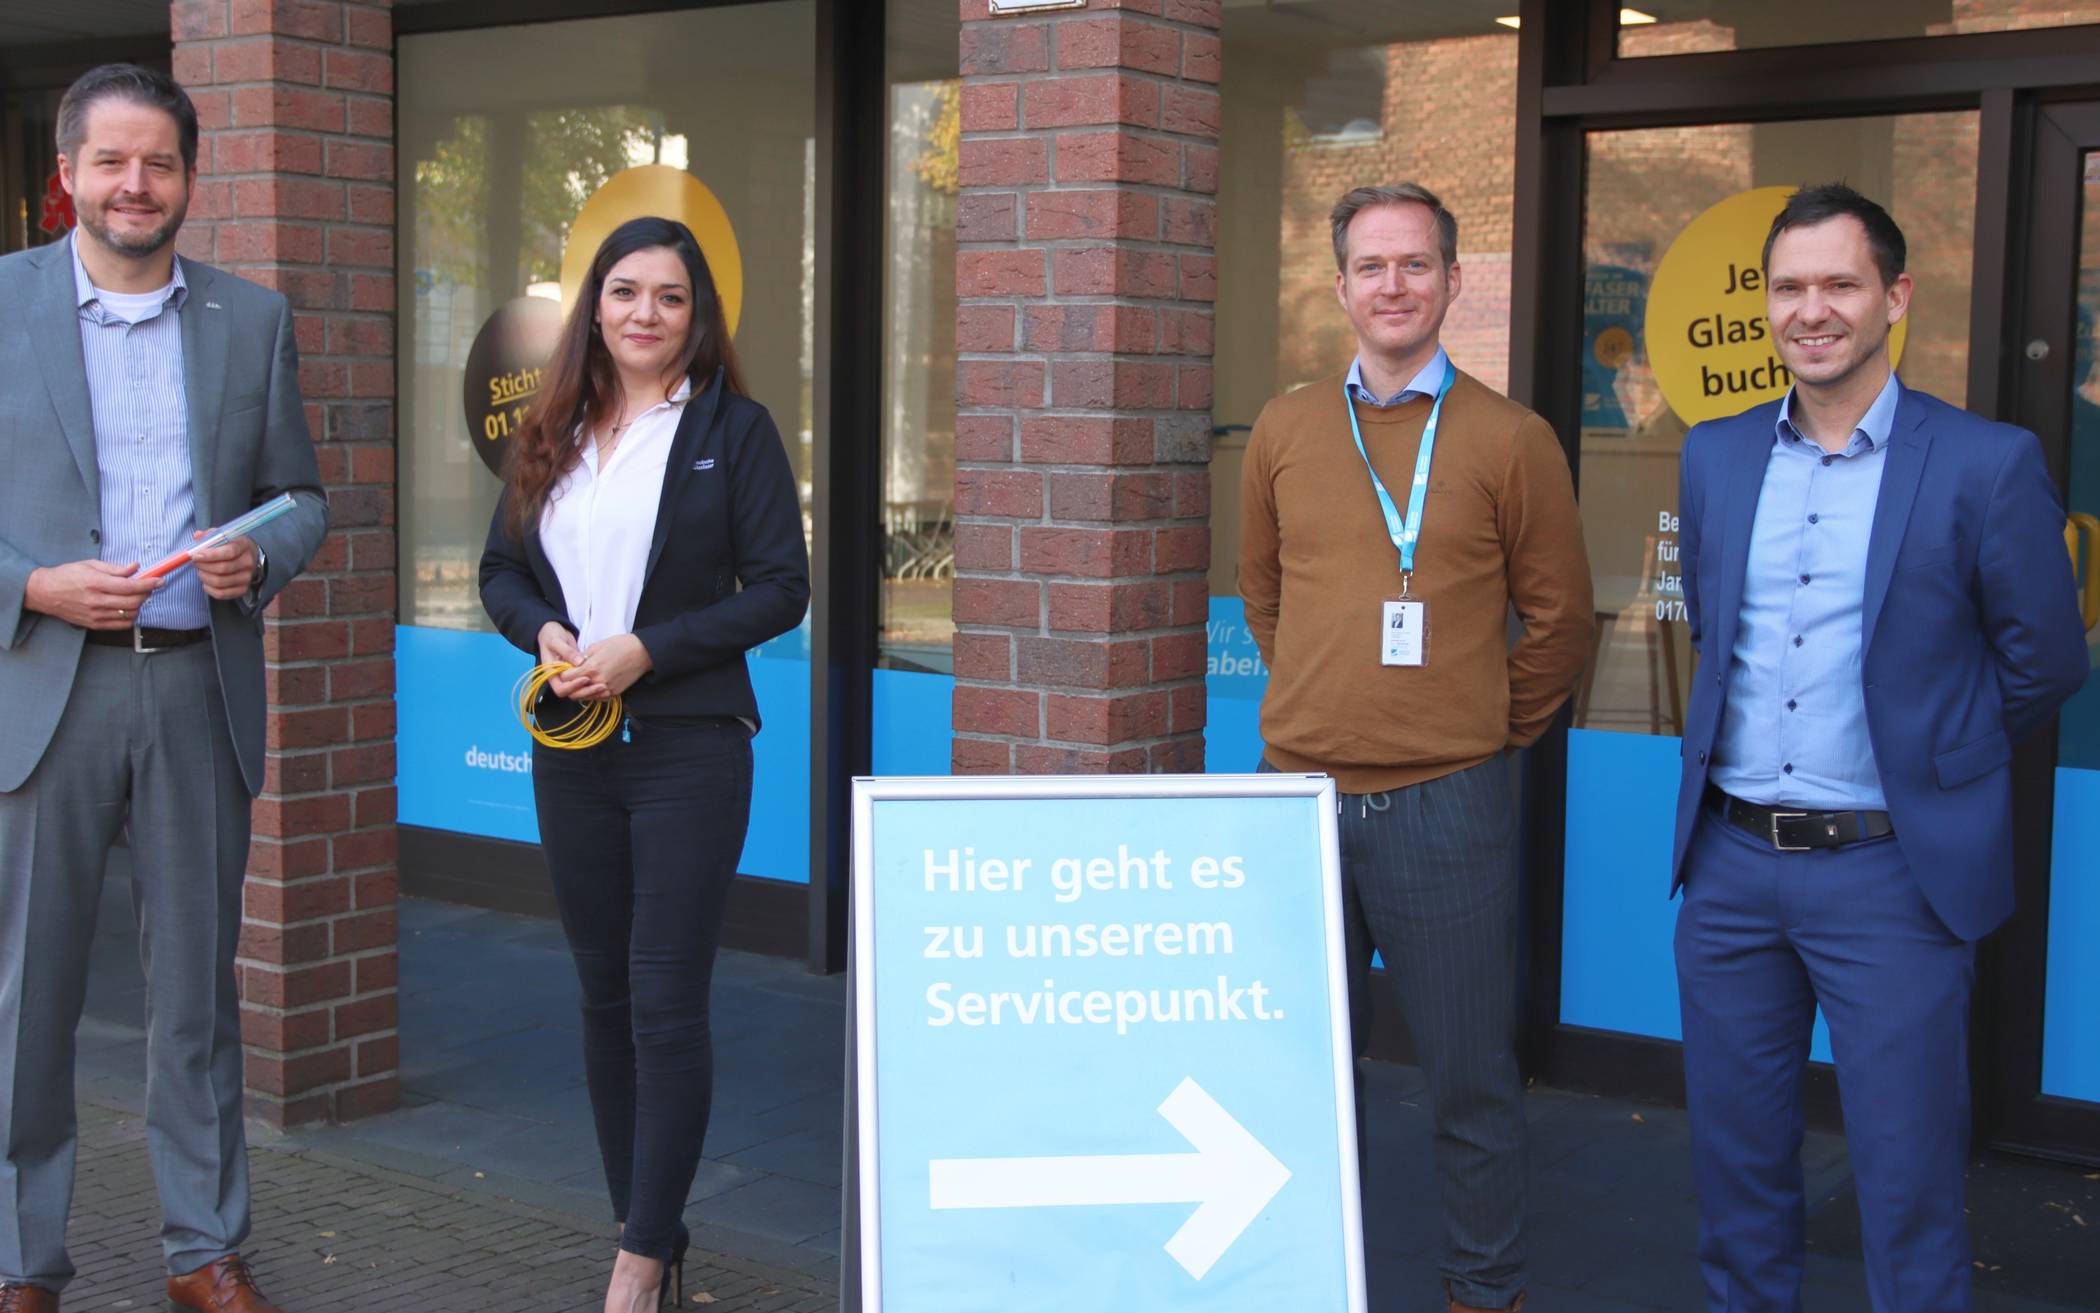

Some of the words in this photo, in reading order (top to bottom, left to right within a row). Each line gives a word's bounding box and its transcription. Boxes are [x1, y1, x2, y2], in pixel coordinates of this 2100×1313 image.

[1725, 263, 1765, 294] Je
[1687, 313, 1769, 348] Glas
[485, 405, 529, 441] 01.1
[465, 745, 533, 773] deutsch
[922, 846, 1033, 893] Hier
[1050, 844, 1173, 903] geht
[1190, 855, 1246, 890] es
[922, 924, 985, 960] zu
[1006, 920, 1234, 958] unserem
[926, 975, 1285, 1035] Servicepunkt.
